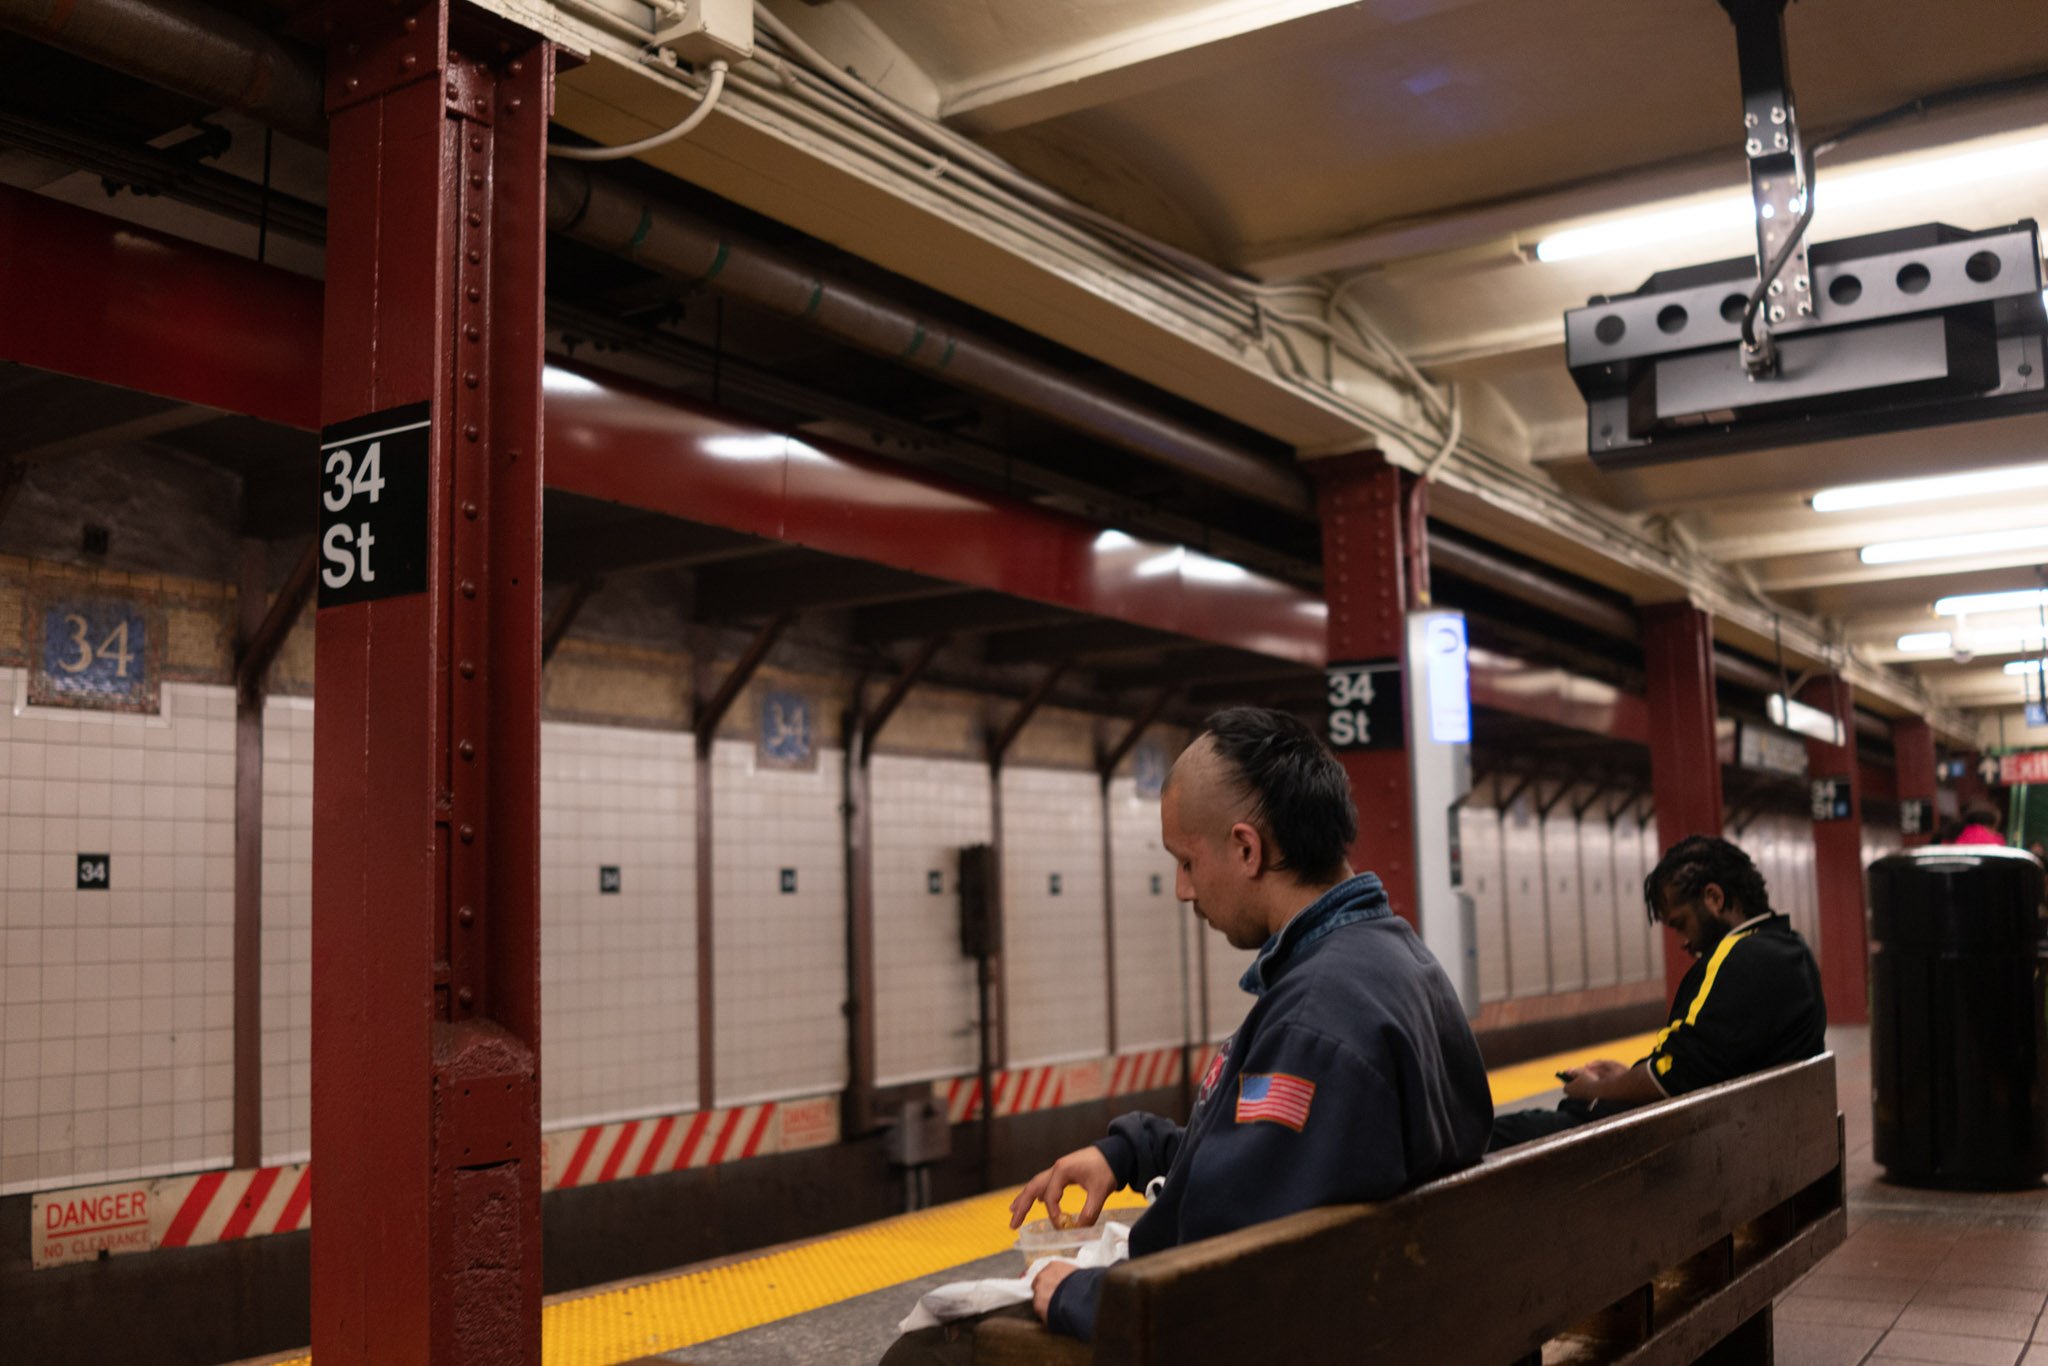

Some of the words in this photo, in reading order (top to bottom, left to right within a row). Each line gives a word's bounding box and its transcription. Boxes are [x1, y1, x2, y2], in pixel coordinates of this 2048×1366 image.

[323, 442, 385, 512] 34
[322, 522, 375, 589] St
[58, 614, 135, 678] 34
[1329, 672, 1375, 708] 34
[1329, 709, 1371, 745] St
[81, 861, 106, 882] 34
[46, 1190, 147, 1231] DANGER
[44, 1243, 65, 1260] NO
[72, 1230, 150, 1257] CLEARANCE
